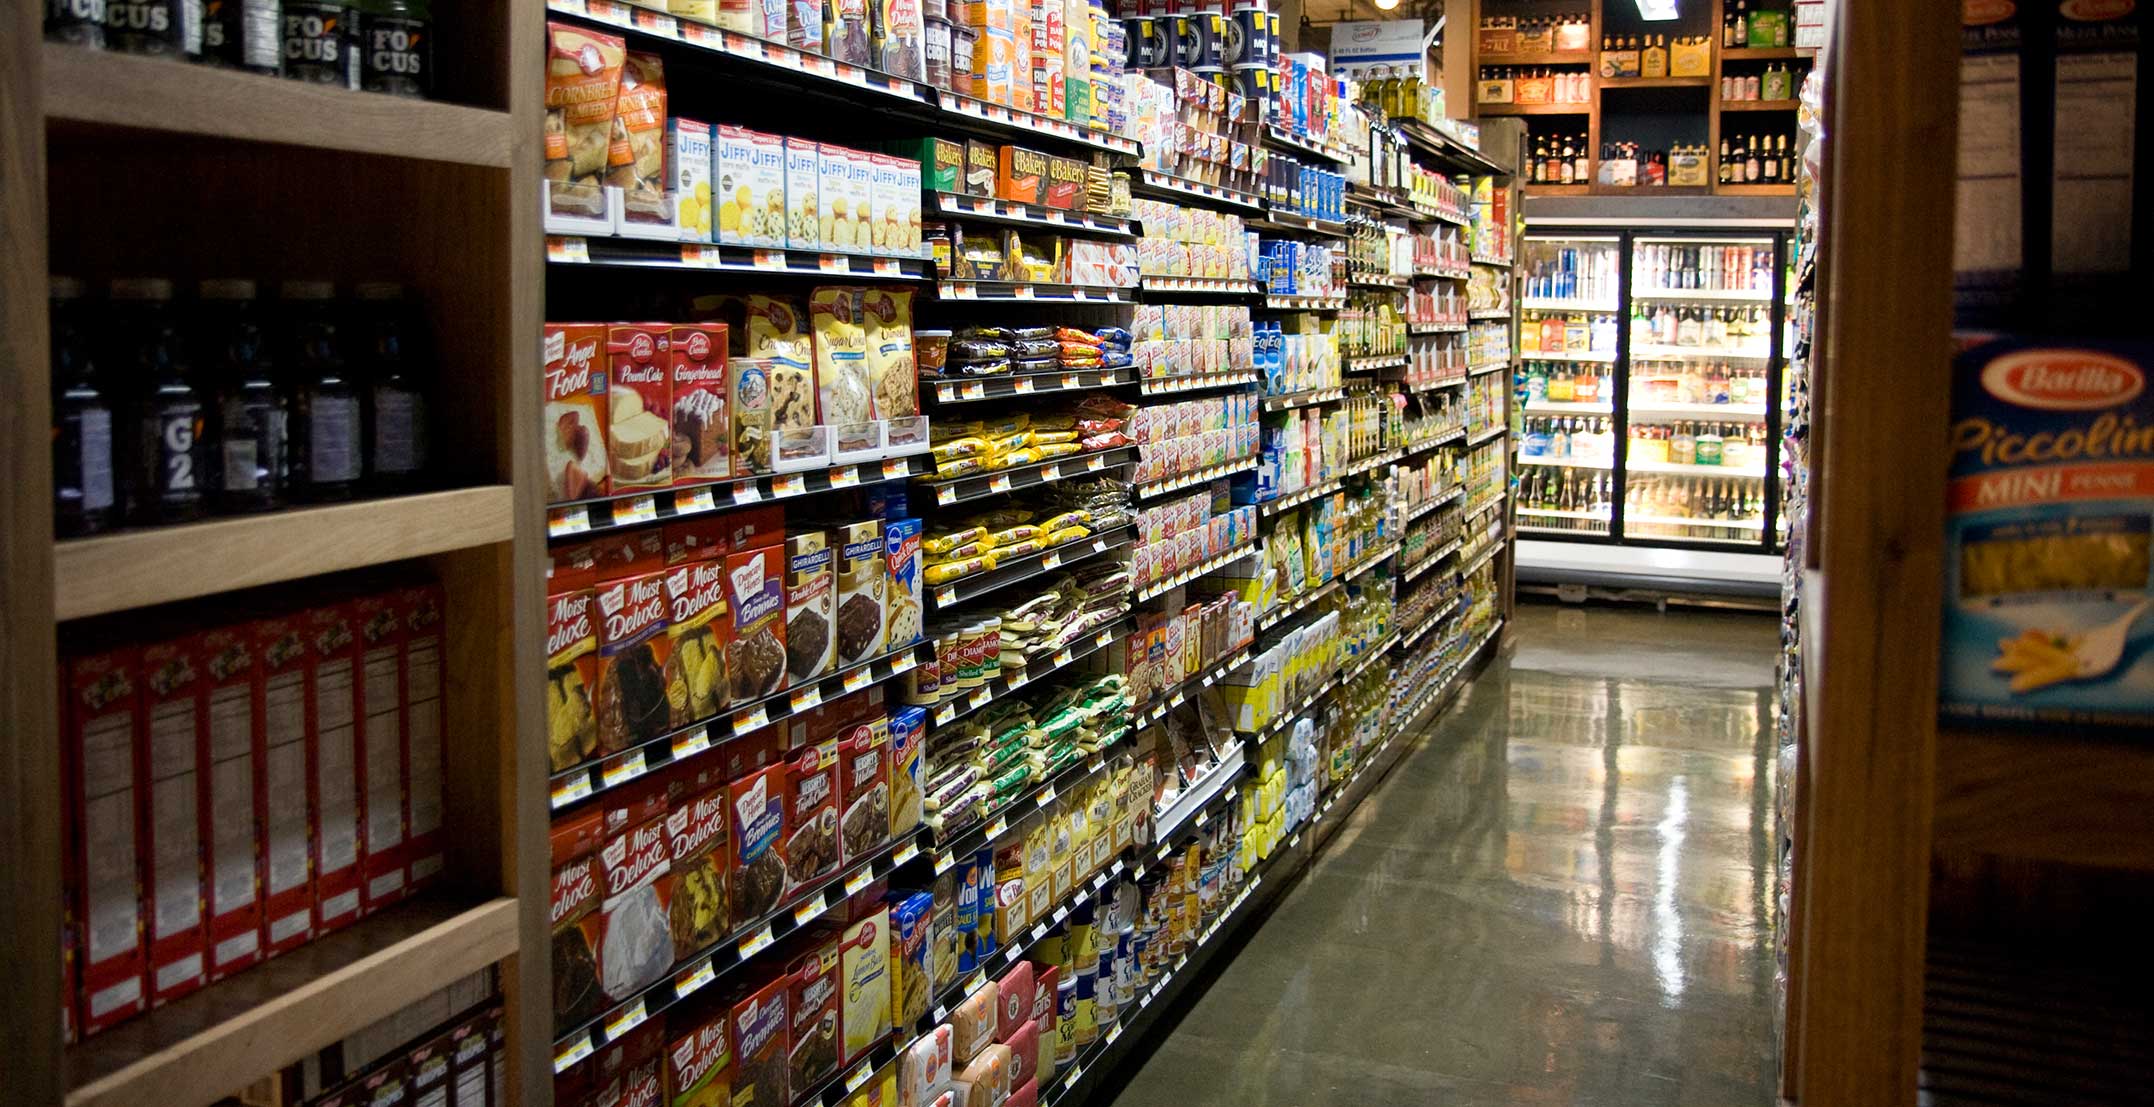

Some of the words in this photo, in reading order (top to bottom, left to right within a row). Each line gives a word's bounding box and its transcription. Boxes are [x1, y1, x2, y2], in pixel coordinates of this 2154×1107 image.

[285, 15, 323, 38] FO
[285, 38, 338, 62] CUS
[374, 29, 410, 52] FO
[372, 51, 421, 74] CUS
[680, 136, 709, 157] JIFFY
[721, 143, 751, 161] JIFFY
[752, 150, 782, 168] JIFFY
[789, 154, 817, 172] JIFFY
[820, 160, 847, 178] JIFFY
[847, 164, 870, 181] JIFFY
[873, 168, 897, 184] JIFFY
[897, 173, 919, 188] JIFFY
[824, 331, 848, 350] Sugar
[563, 341, 597, 368] Angel
[546, 362, 590, 400] Food
[620, 365, 646, 383] Pound
[645, 365, 665, 383] Cake
[675, 364, 723, 385] Gingerbread
[2021, 367, 2124, 393] Barilla
[165, 418, 193, 453] G
[1951, 410, 2154, 465] Piccolin
[168, 454, 195, 490] 2
[1977, 471, 2062, 502] MINI
[792, 551, 831, 569] GHIRARDELLI
[845, 540, 882, 557] GHIRARDELLI
[691, 564, 721, 589] Moist
[627, 579, 663, 607] Moist
[672, 581, 723, 622] Deluxe
[551, 595, 591, 625] Moist
[606, 597, 665, 641] Deluxe
[548, 615, 592, 654] eluxe
[691, 795, 723, 824] Moist
[629, 823, 664, 856] Moist
[672, 811, 724, 860] Deluxe
[555, 856, 595, 892] Moist
[609, 840, 666, 894] Deluxe
[551, 874, 596, 922] eluxe
[695, 1017, 727, 1054] Moist
[679, 1034, 727, 1093] Deluxe
